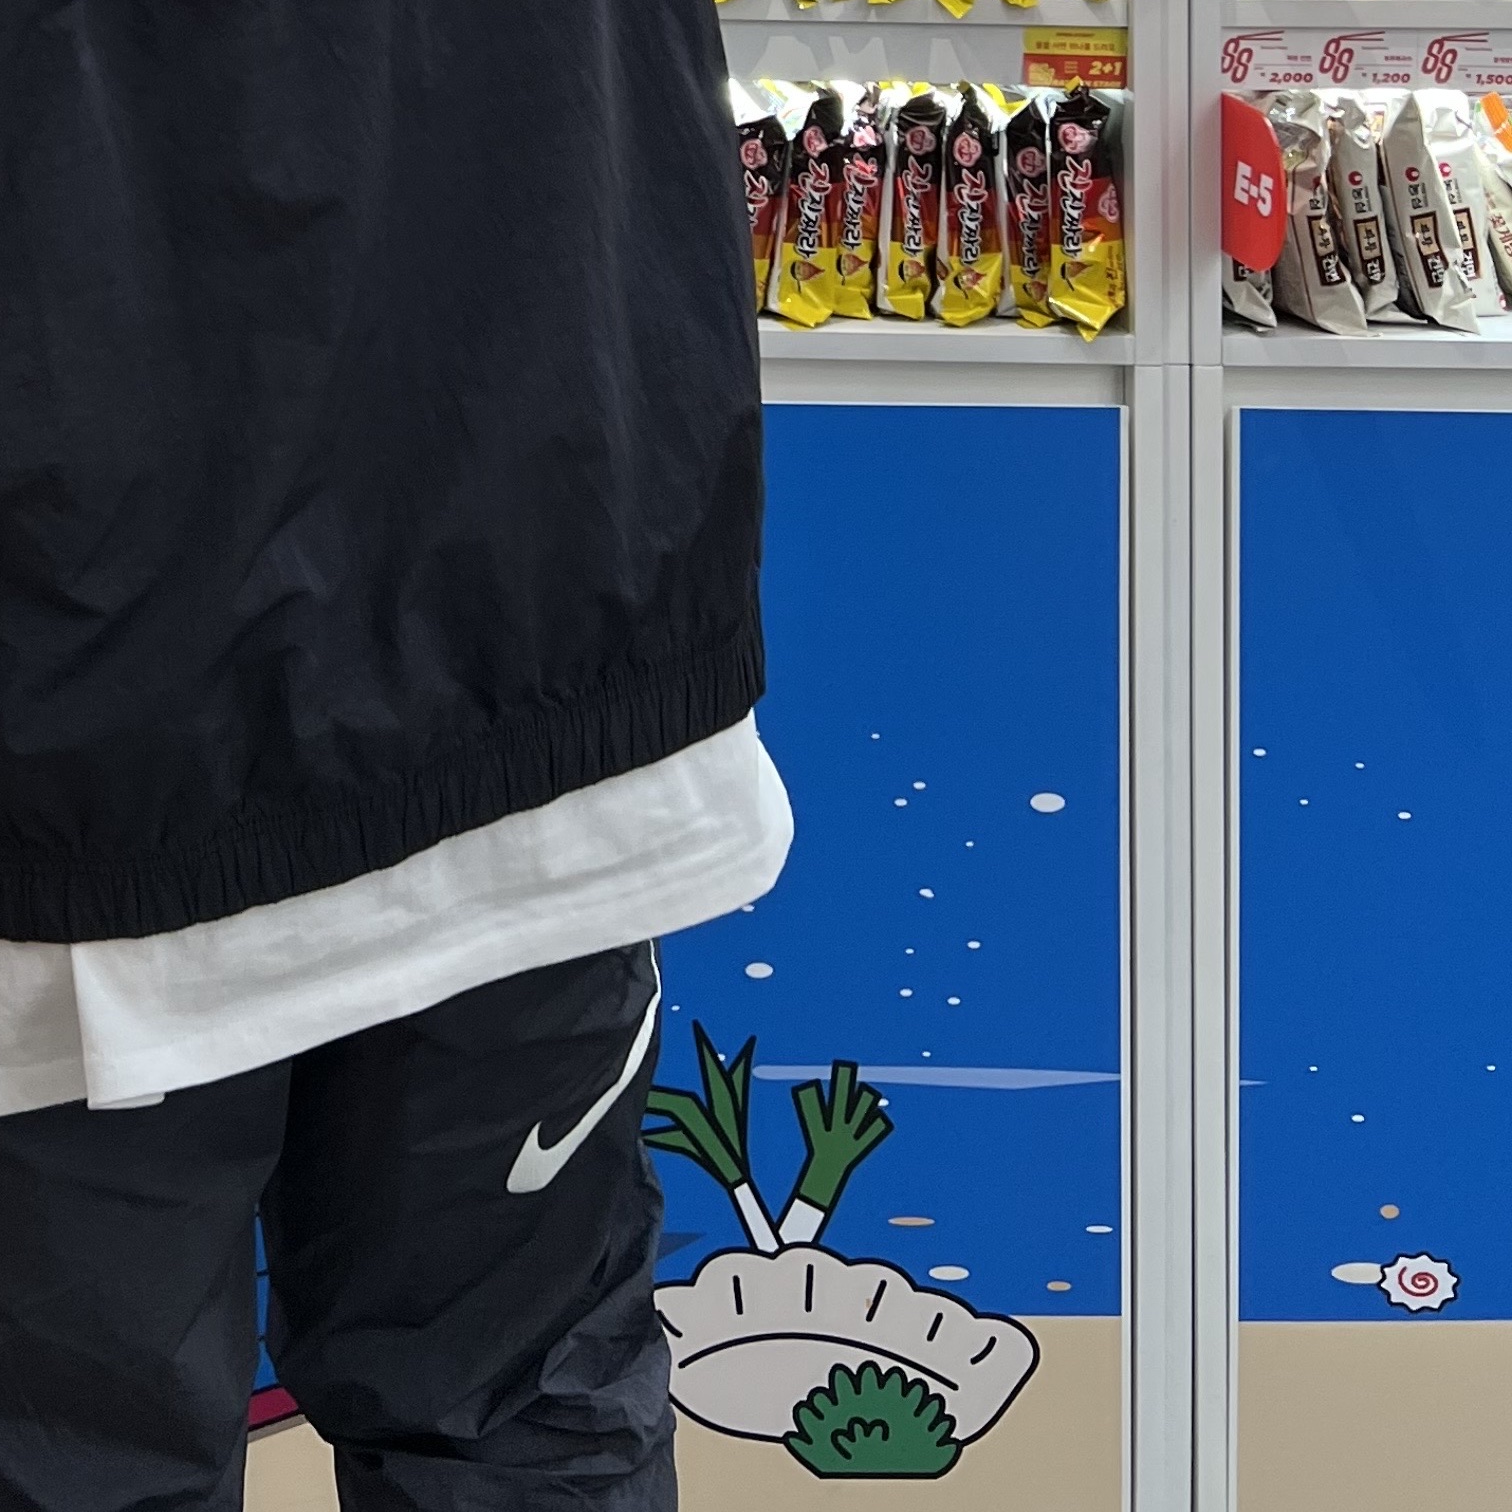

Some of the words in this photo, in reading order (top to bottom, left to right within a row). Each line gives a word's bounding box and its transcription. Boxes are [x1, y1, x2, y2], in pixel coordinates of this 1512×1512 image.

[1089, 61, 1122, 75] 2+1
[1269, 71, 1312, 83] 2,000
[1372, 72, 1411, 83] 1,200
[1234, 161, 1273, 217] E-5
